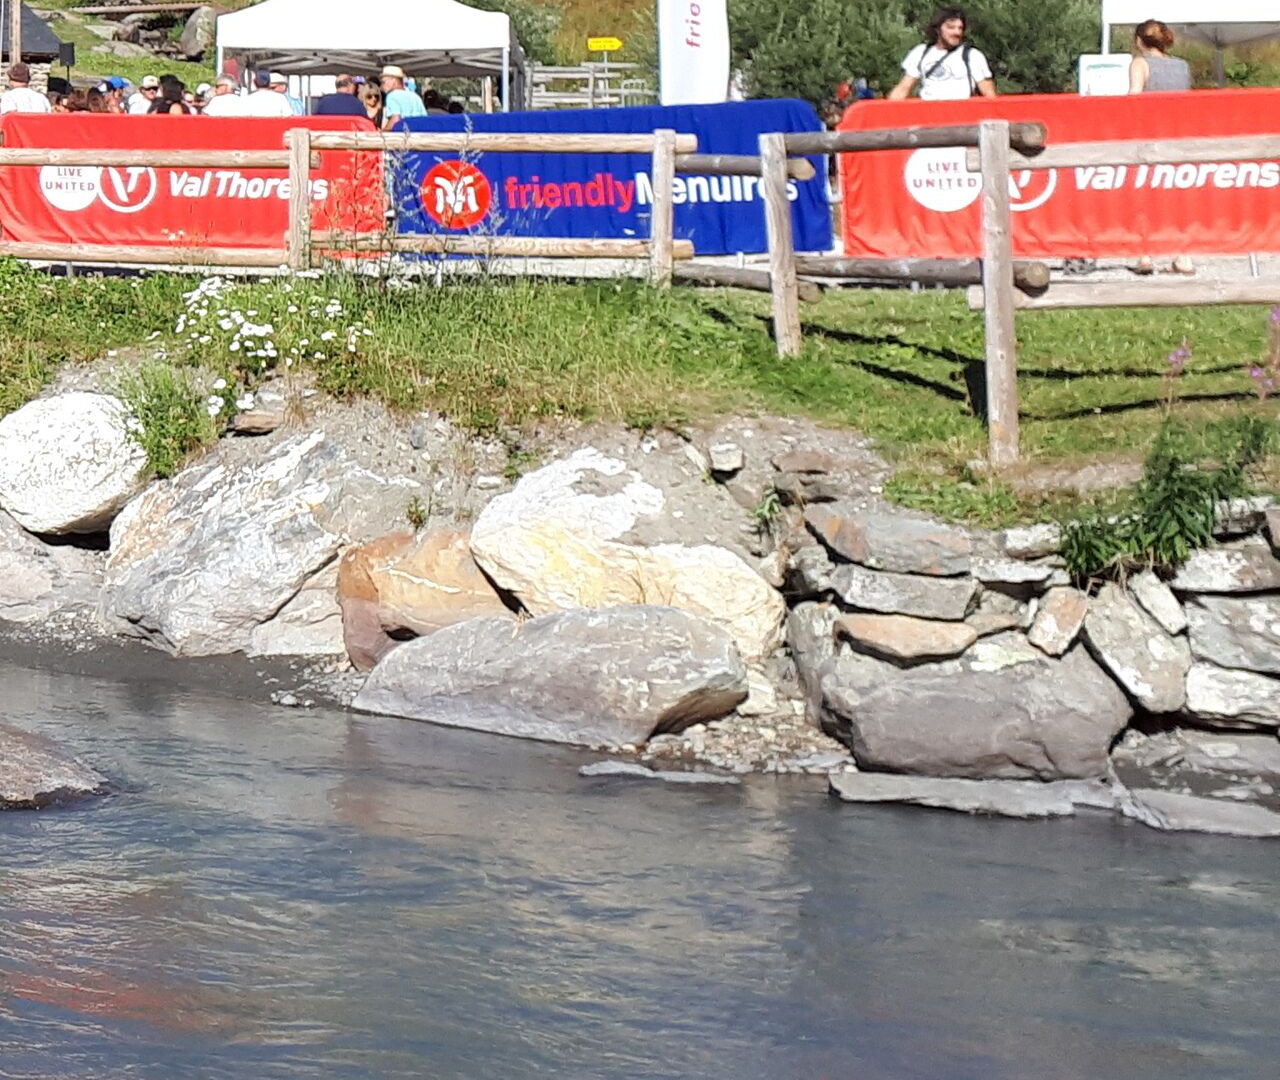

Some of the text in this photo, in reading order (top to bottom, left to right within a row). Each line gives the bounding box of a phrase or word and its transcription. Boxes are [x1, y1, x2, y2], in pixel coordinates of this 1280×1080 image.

[56, 167, 83, 178] LIVE
[926, 162, 961, 174] LIVE
[45, 181, 96, 192] UNITED
[169, 170, 330, 200] Val Thores
[912, 176, 978, 189] UNITED
